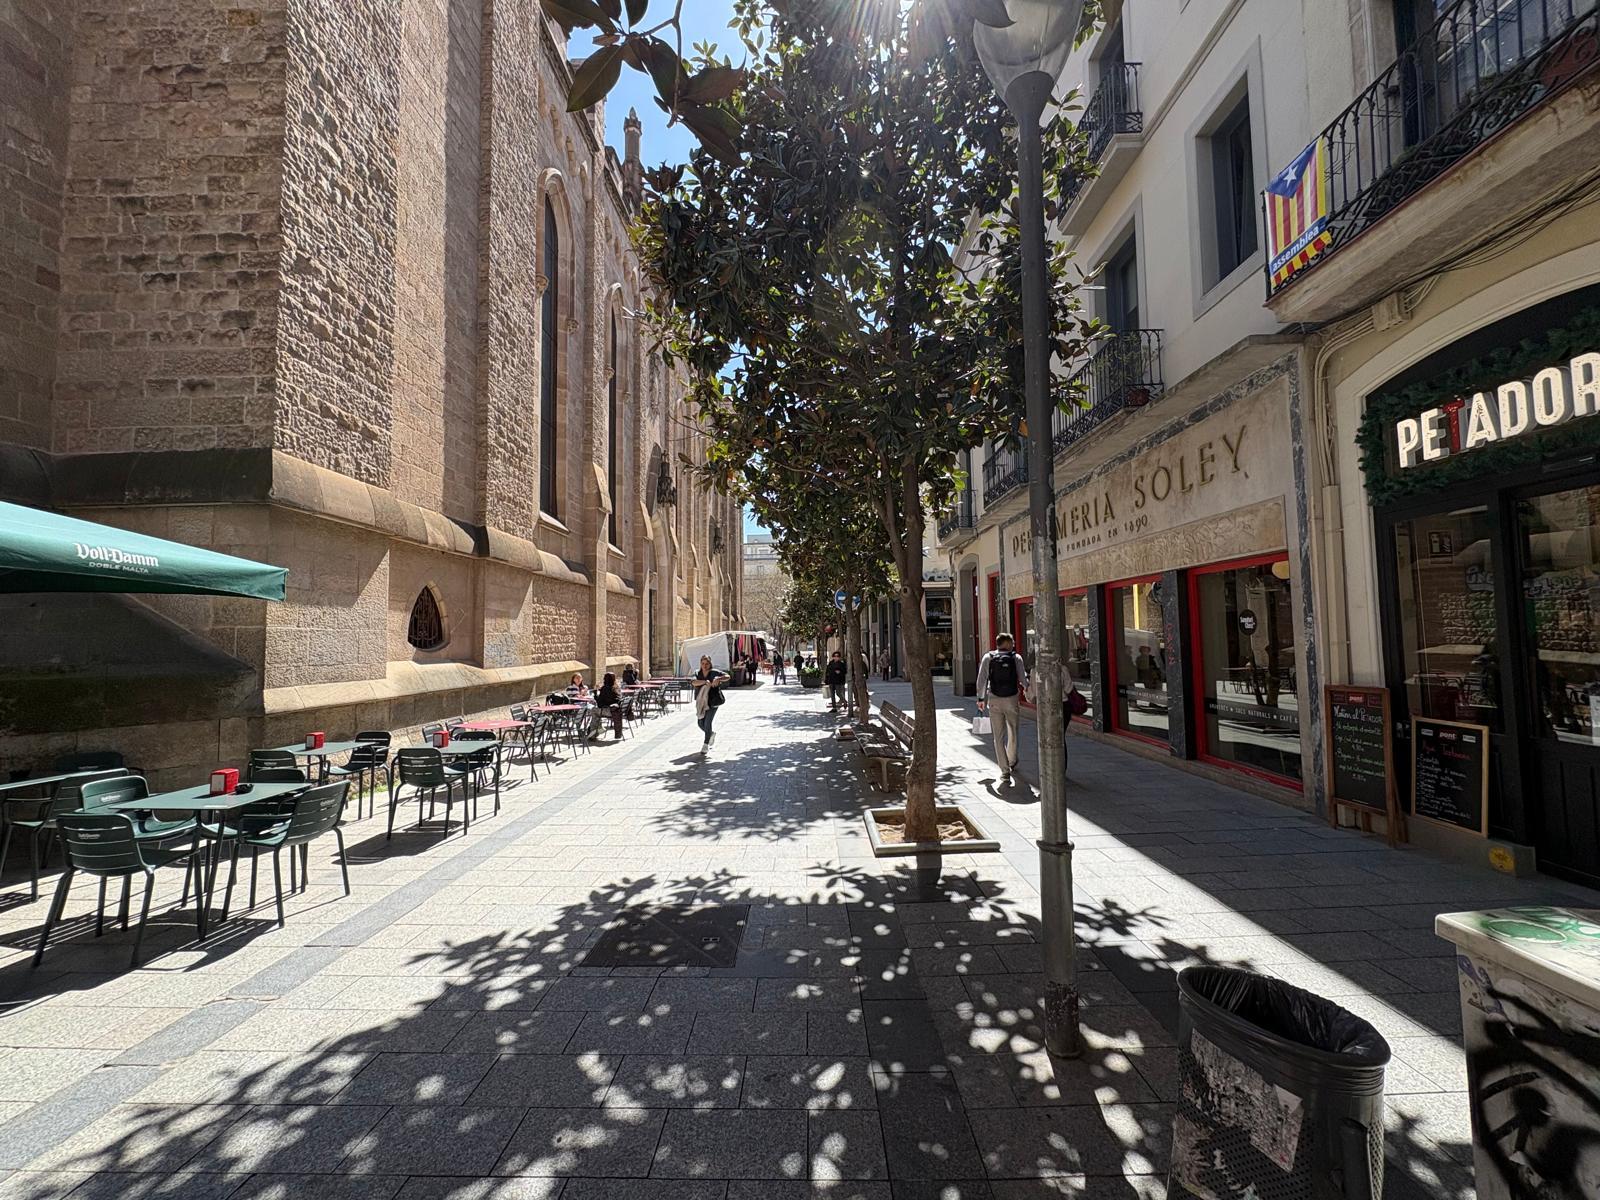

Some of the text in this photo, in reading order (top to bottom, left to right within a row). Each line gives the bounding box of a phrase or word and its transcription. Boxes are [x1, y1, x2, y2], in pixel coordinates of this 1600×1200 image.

[1272, 225, 1320, 272] assemblea
[1107, 527, 1119, 538] EN
[1124, 514, 1148, 533] 1890
[72, 542, 160, 567] Voll-Damm
[88, 561, 149, 574] DOBLE MALTA
[1439, 731, 1457, 740] pont
